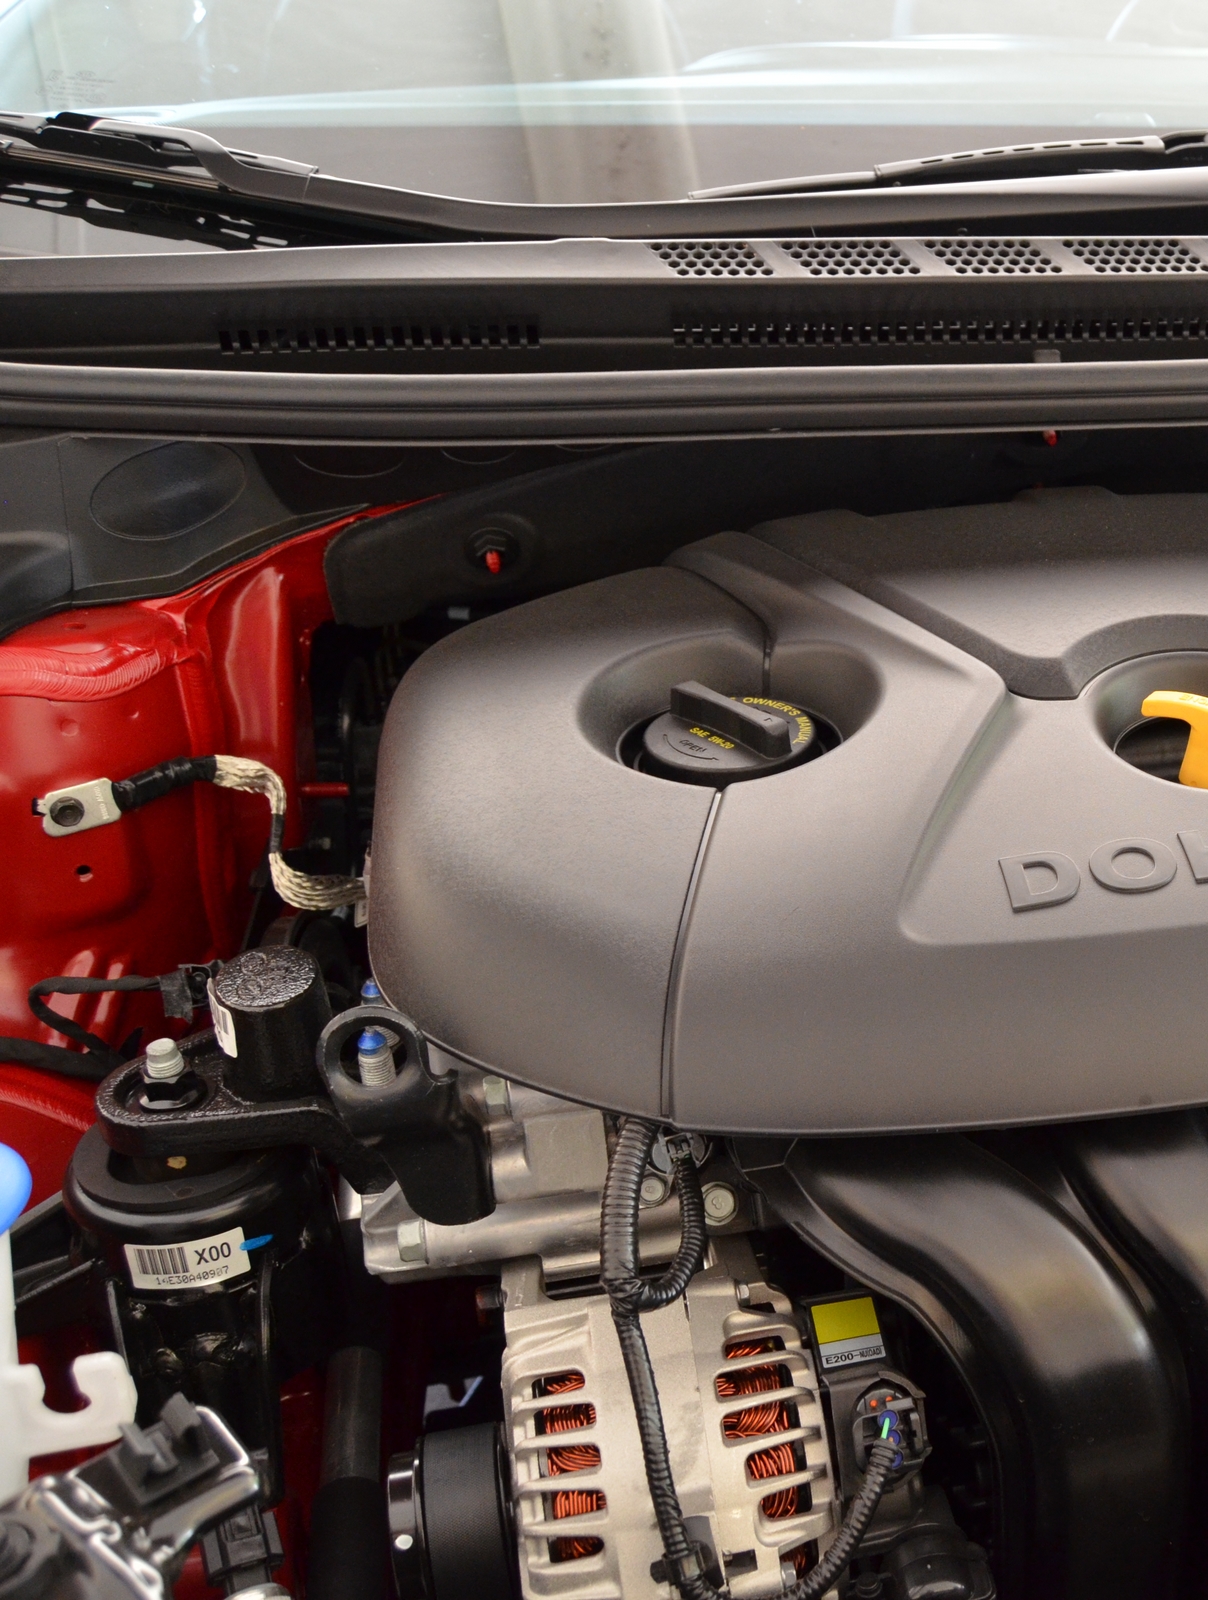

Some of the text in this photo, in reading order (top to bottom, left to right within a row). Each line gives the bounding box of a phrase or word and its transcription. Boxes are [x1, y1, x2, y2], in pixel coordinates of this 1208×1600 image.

[742, 697, 812, 744] OWNER'S MANUAL
[679, 739, 707, 753] OPEN
[689, 727, 735, 749] SAE 5W-20
